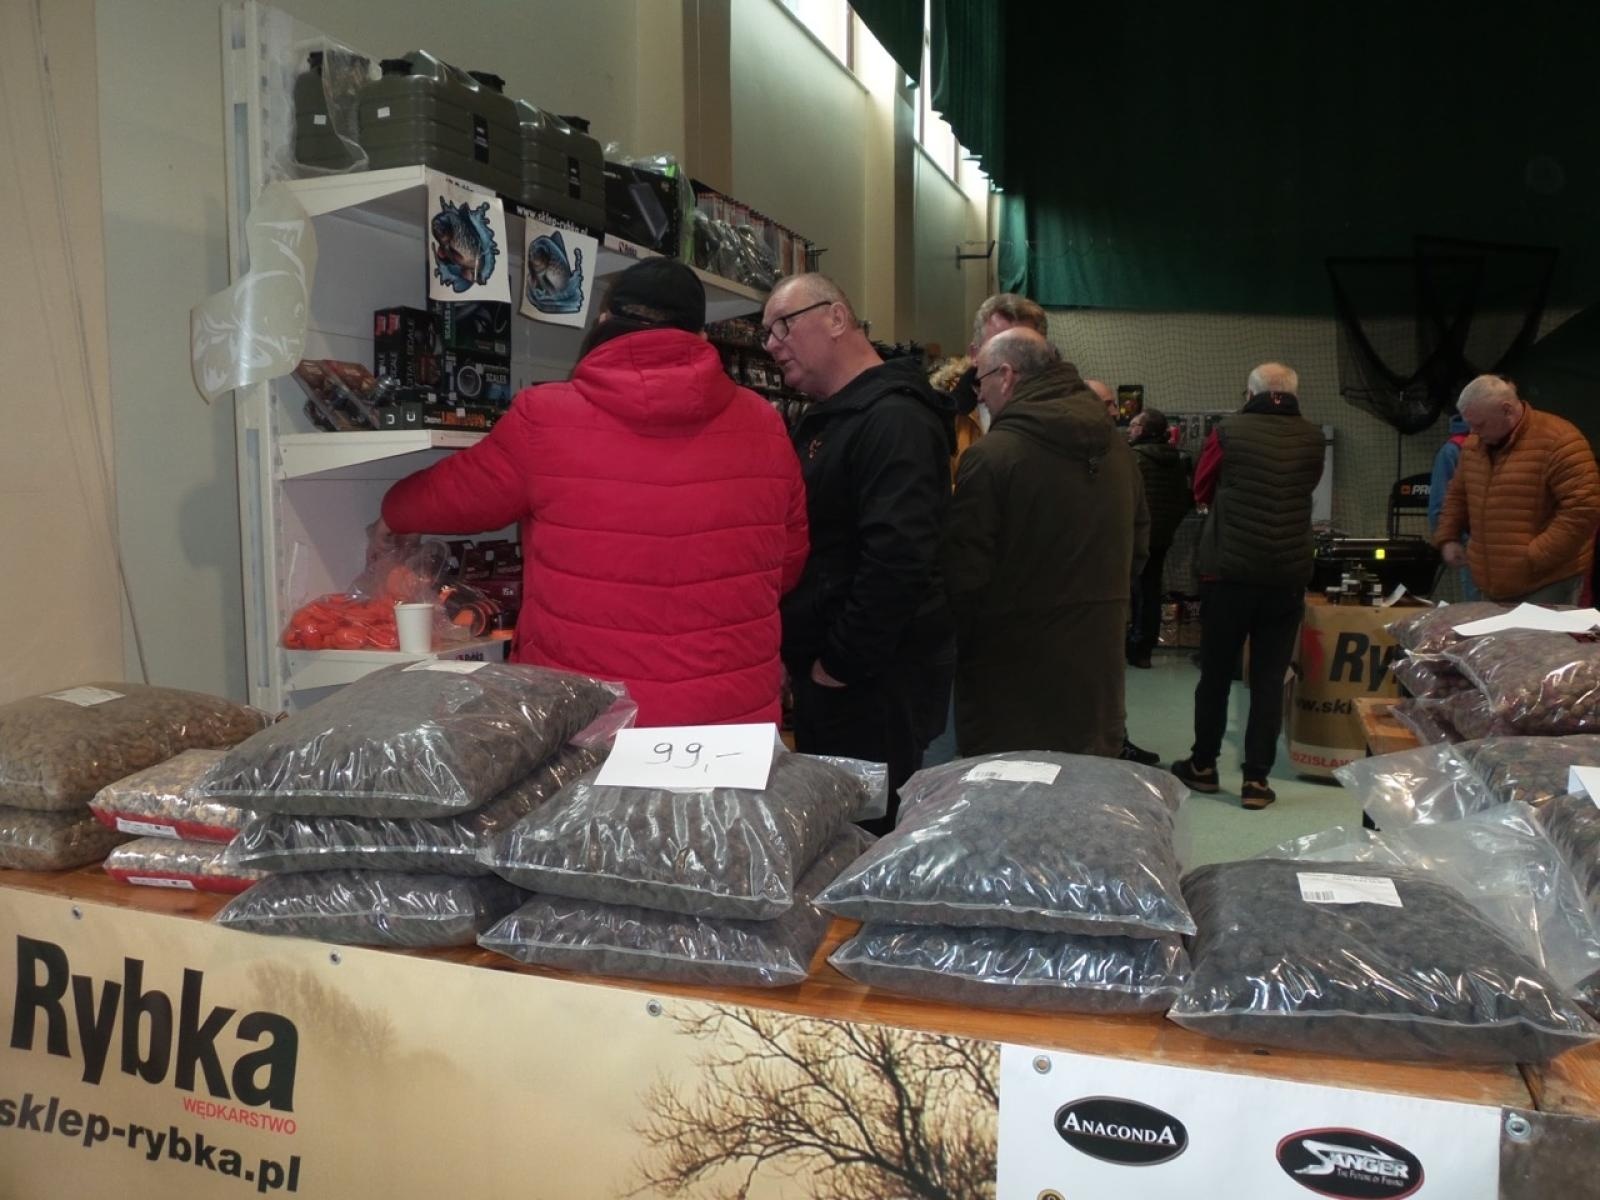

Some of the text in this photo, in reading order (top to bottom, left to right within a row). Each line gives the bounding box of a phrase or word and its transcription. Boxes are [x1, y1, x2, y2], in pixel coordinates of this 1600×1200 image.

[10, 934, 299, 1112] Rybka
[0, 1093, 301, 1193] sklep-rybka.pl
[183, 1096, 297, 1135] WĘDKARSTWO
[1062, 1111, 1177, 1146] ANACONDA
